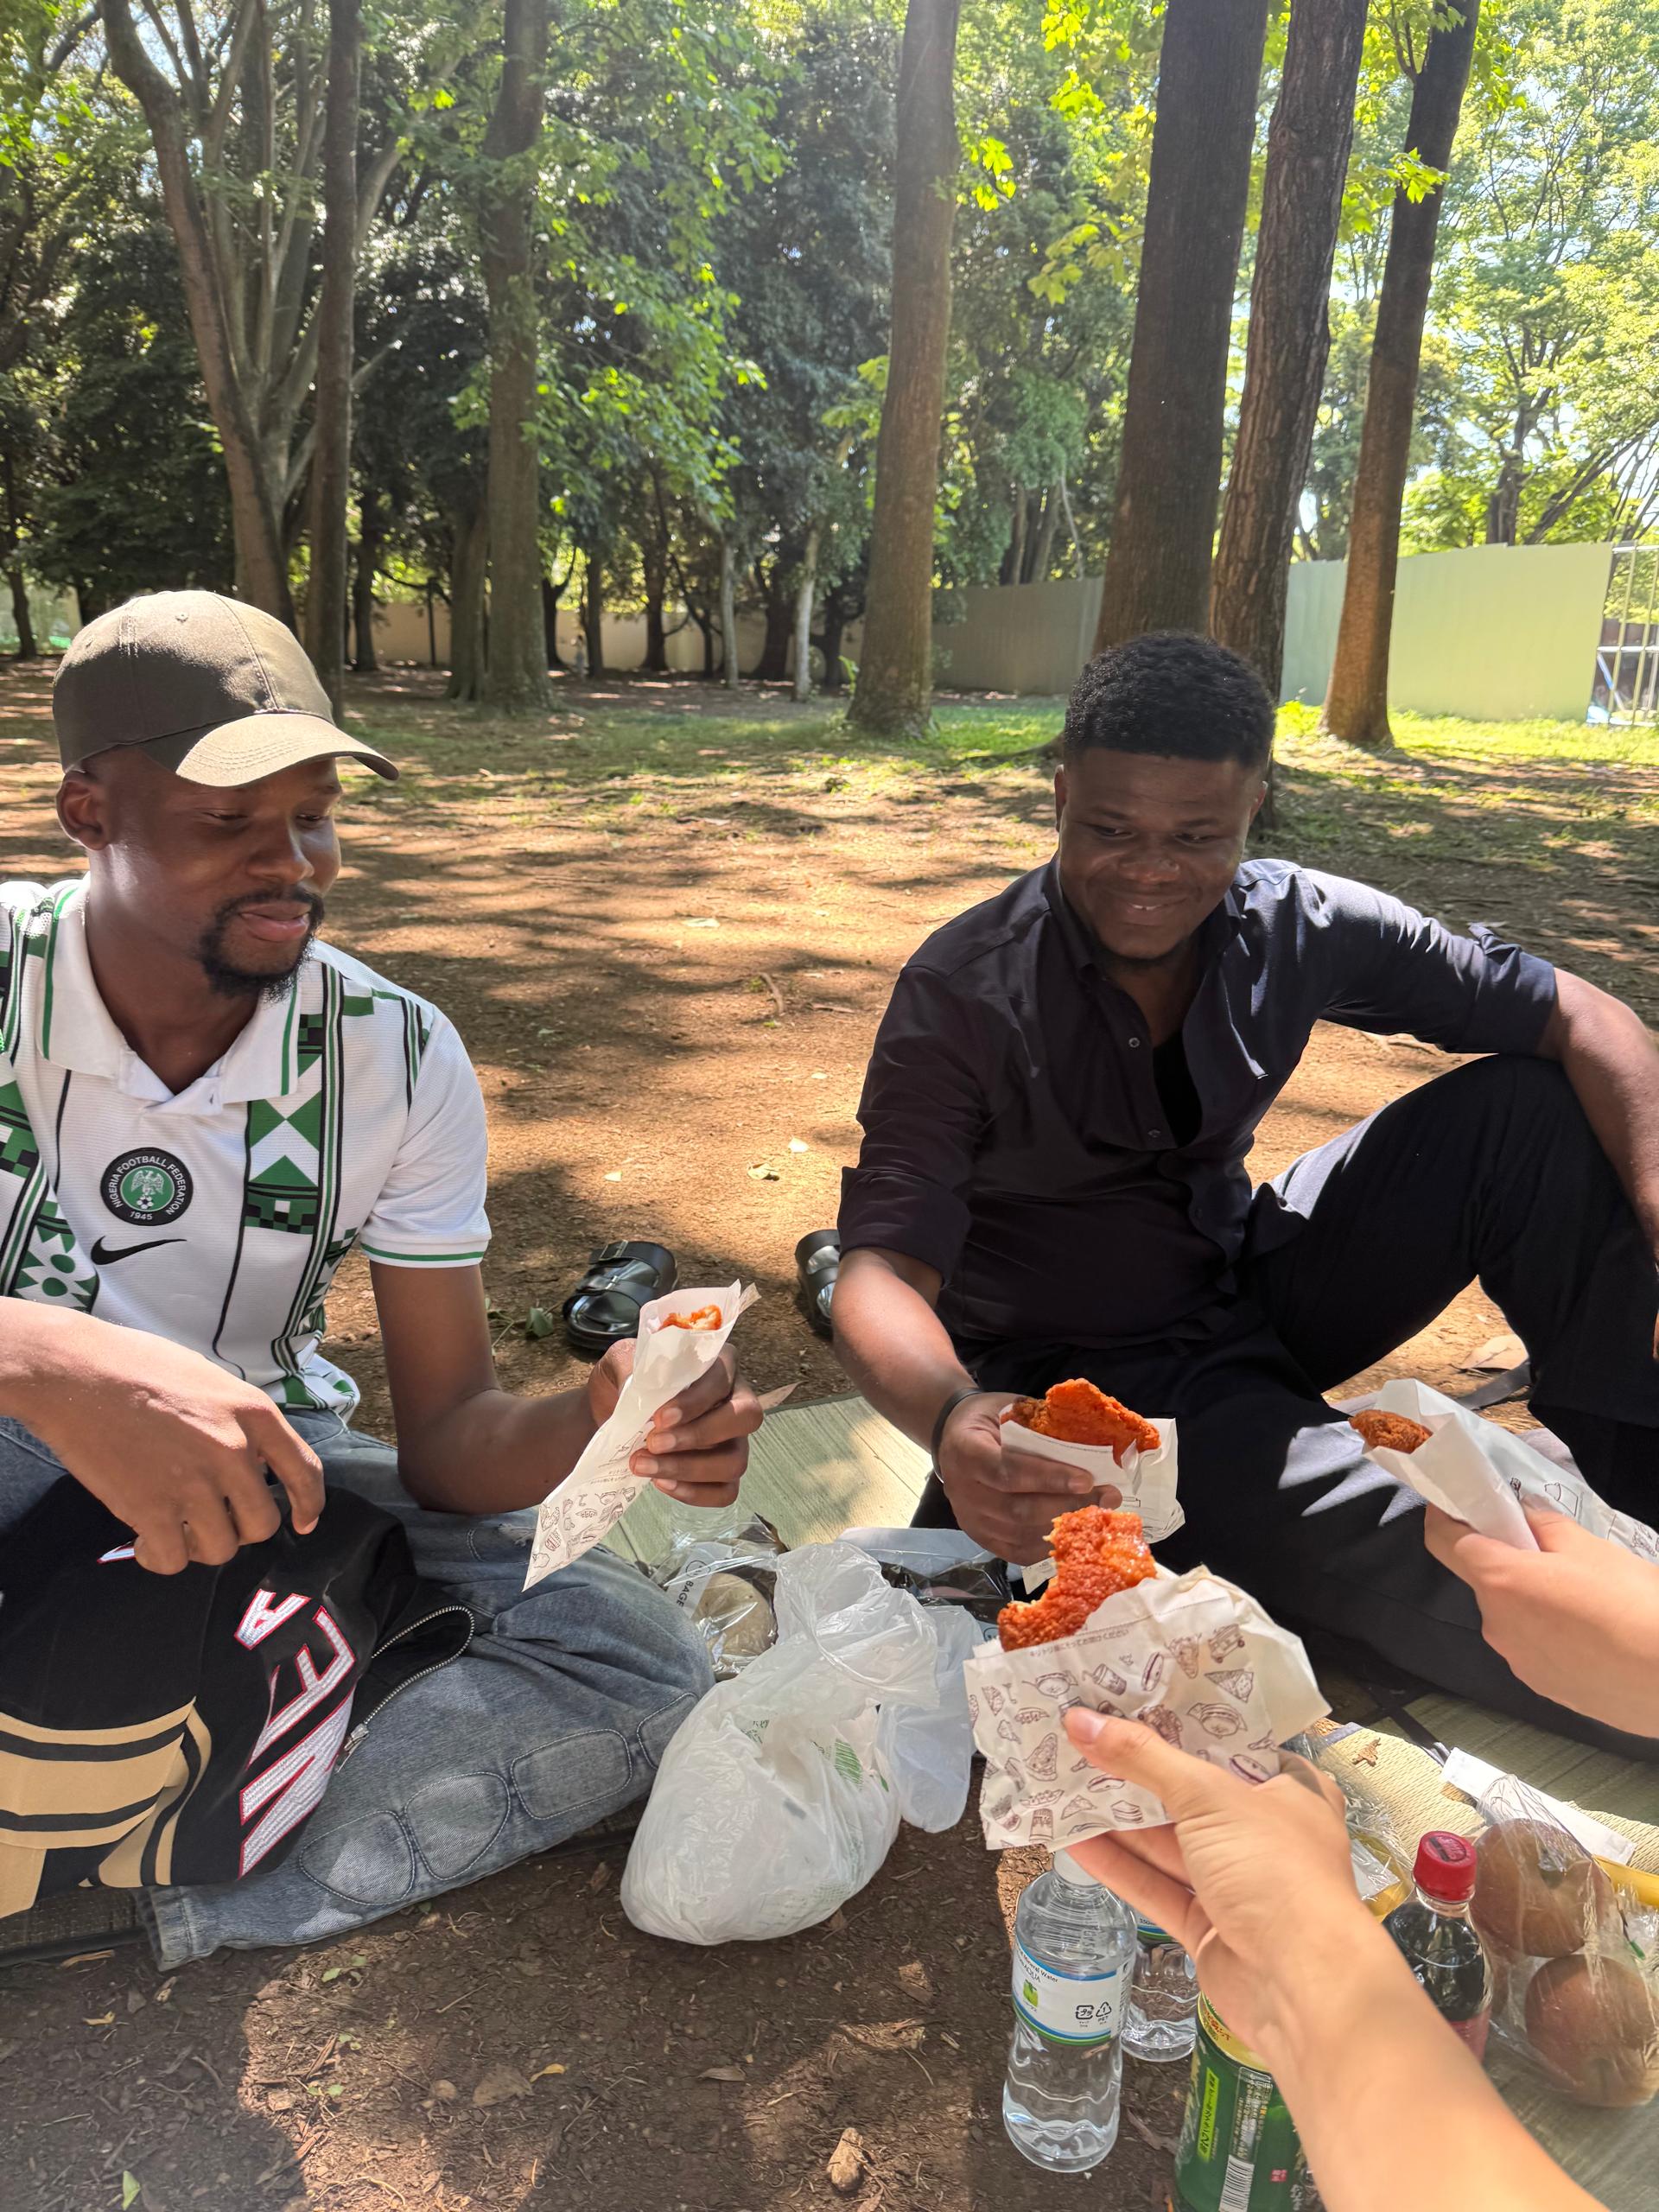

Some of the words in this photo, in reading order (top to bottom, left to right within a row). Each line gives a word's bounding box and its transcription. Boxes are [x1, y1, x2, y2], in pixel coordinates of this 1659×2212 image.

[108, 1173, 124, 1208] NIGERIA
[117, 1155, 167, 1174] FOOTBALL
[165, 1164, 188, 1215] FEDERATION
[130, 1211, 153, 1220] 1945
[676, 1580, 695, 1608] BAGE
[1040, 1971, 1059, 1983] Water
